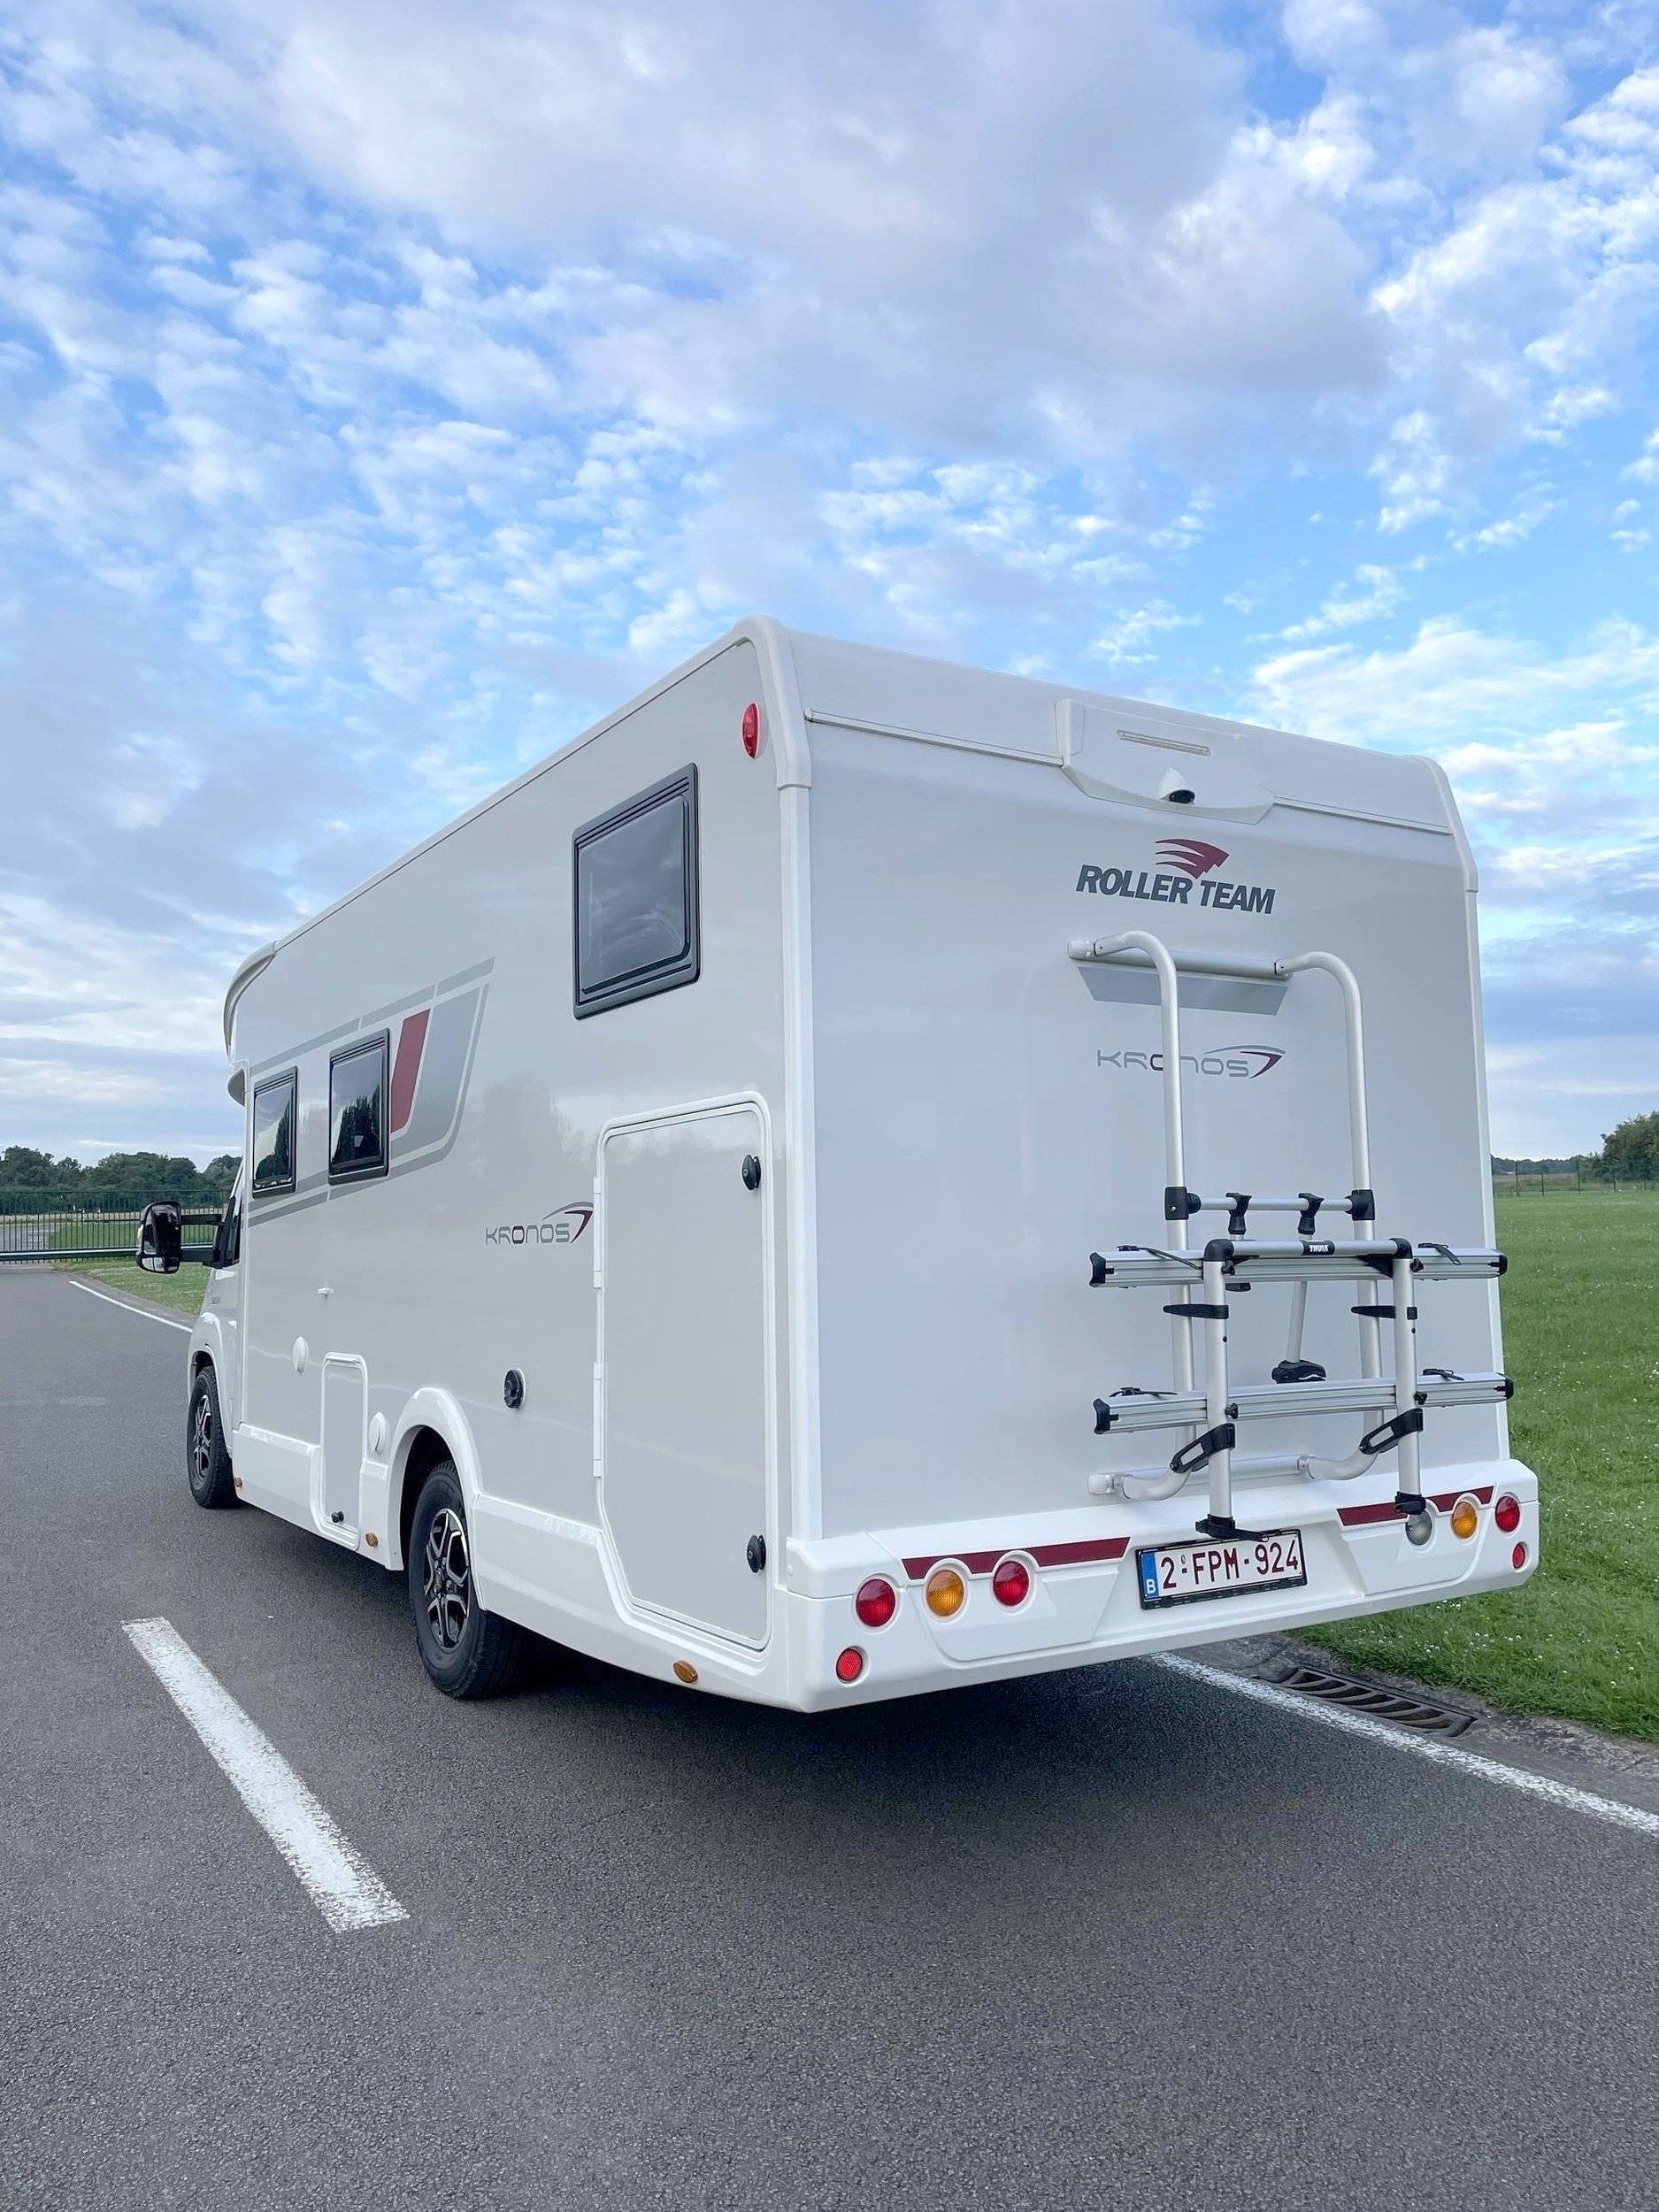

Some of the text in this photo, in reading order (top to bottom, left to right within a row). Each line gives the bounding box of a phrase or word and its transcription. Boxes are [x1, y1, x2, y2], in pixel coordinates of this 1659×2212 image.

[1075, 864, 1276, 915] ROLLER TEAM
[485, 1222, 571, 1245] KRONOS
[1146, 1578, 1156, 1594] B
